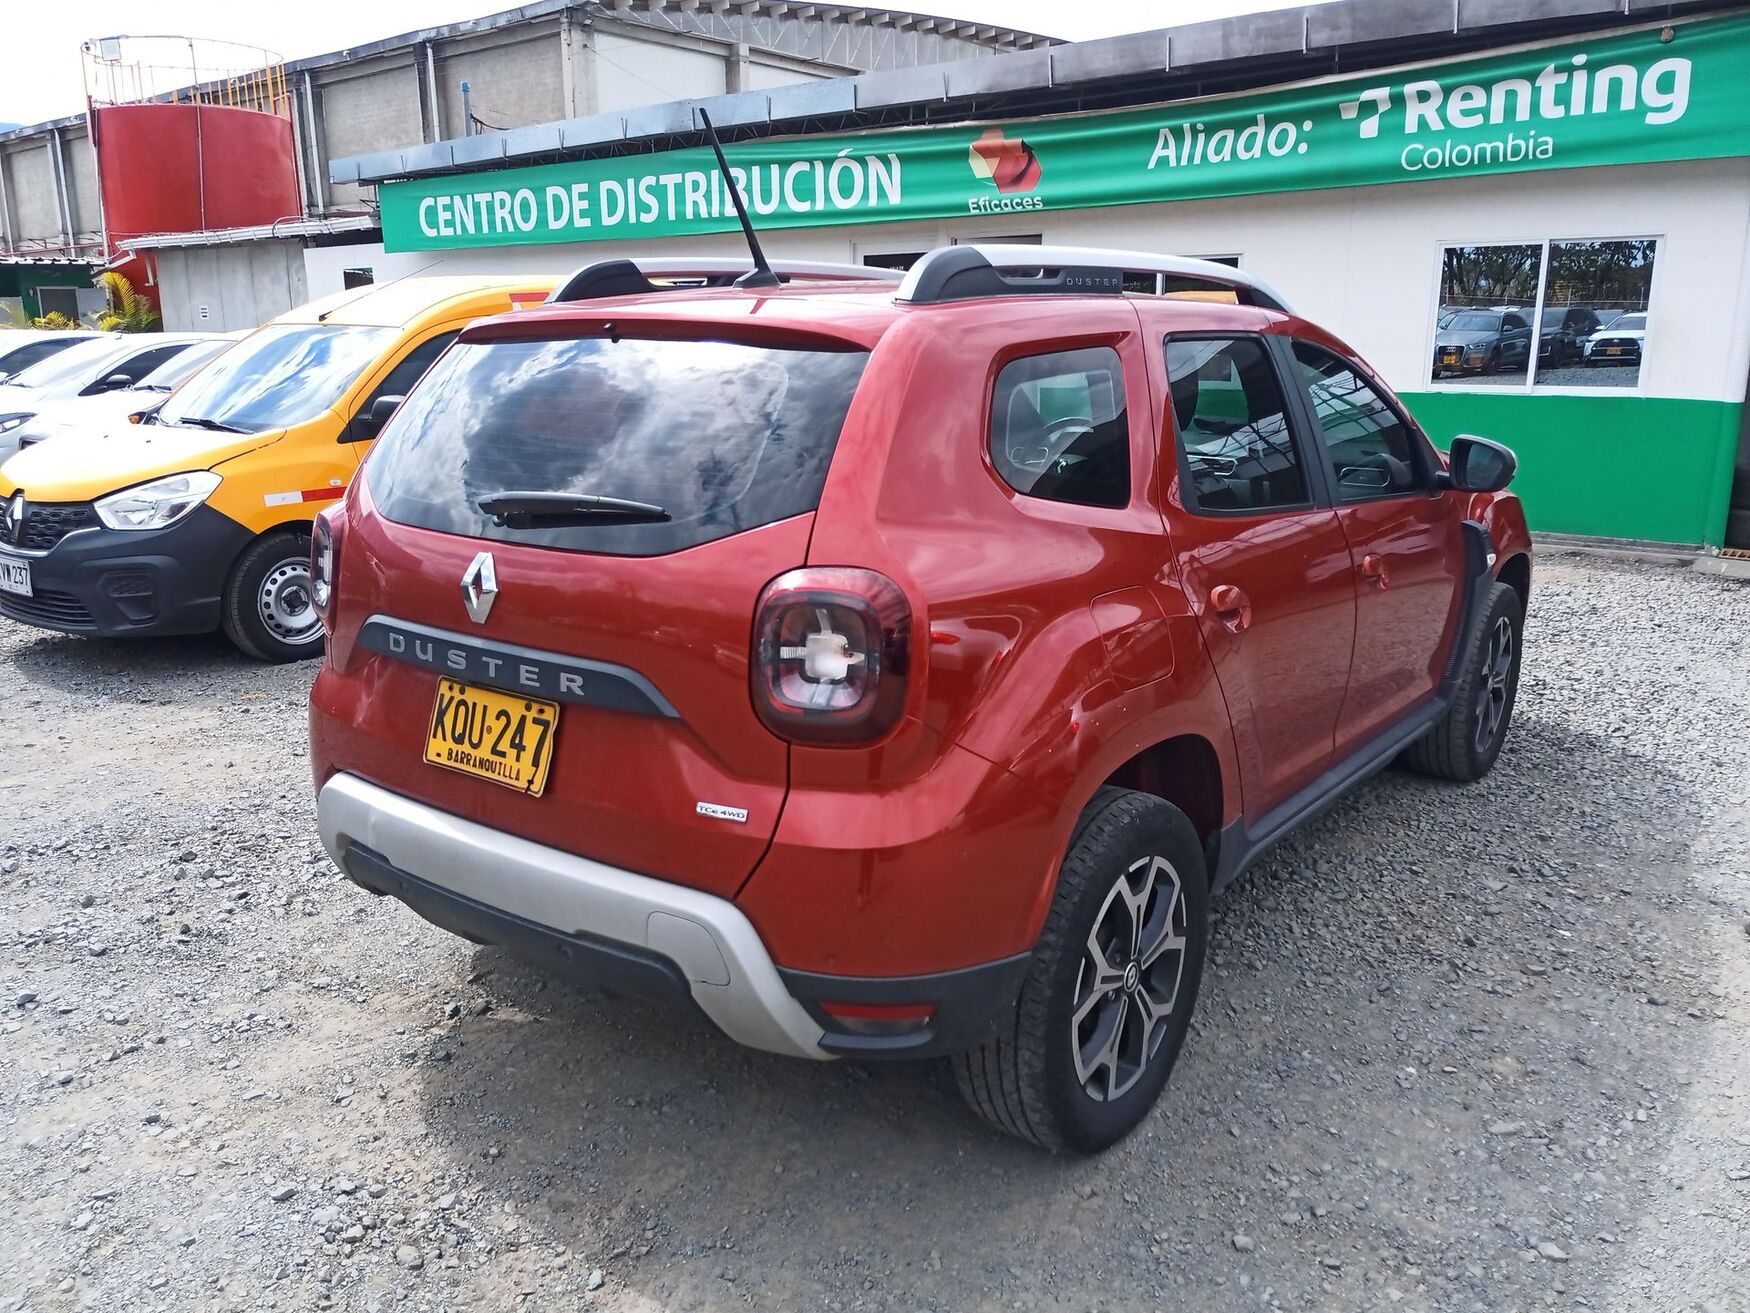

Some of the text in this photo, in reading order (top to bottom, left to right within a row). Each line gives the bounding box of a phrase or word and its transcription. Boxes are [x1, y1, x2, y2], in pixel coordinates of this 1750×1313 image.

[1147, 55, 1692, 169] Aliado: Renting
[1401, 131, 1554, 172] Colombia
[419, 149, 902, 237] CENTRO DE DISTRIBUCIÓN
[968, 196, 1043, 213] Eficaces
[1066, 278, 1118, 286] DUSTER
[389, 632, 585, 696] DUSTER
[446, 747, 520, 781] BARRANQUILLA
[720, 810, 745, 819] 4WD
